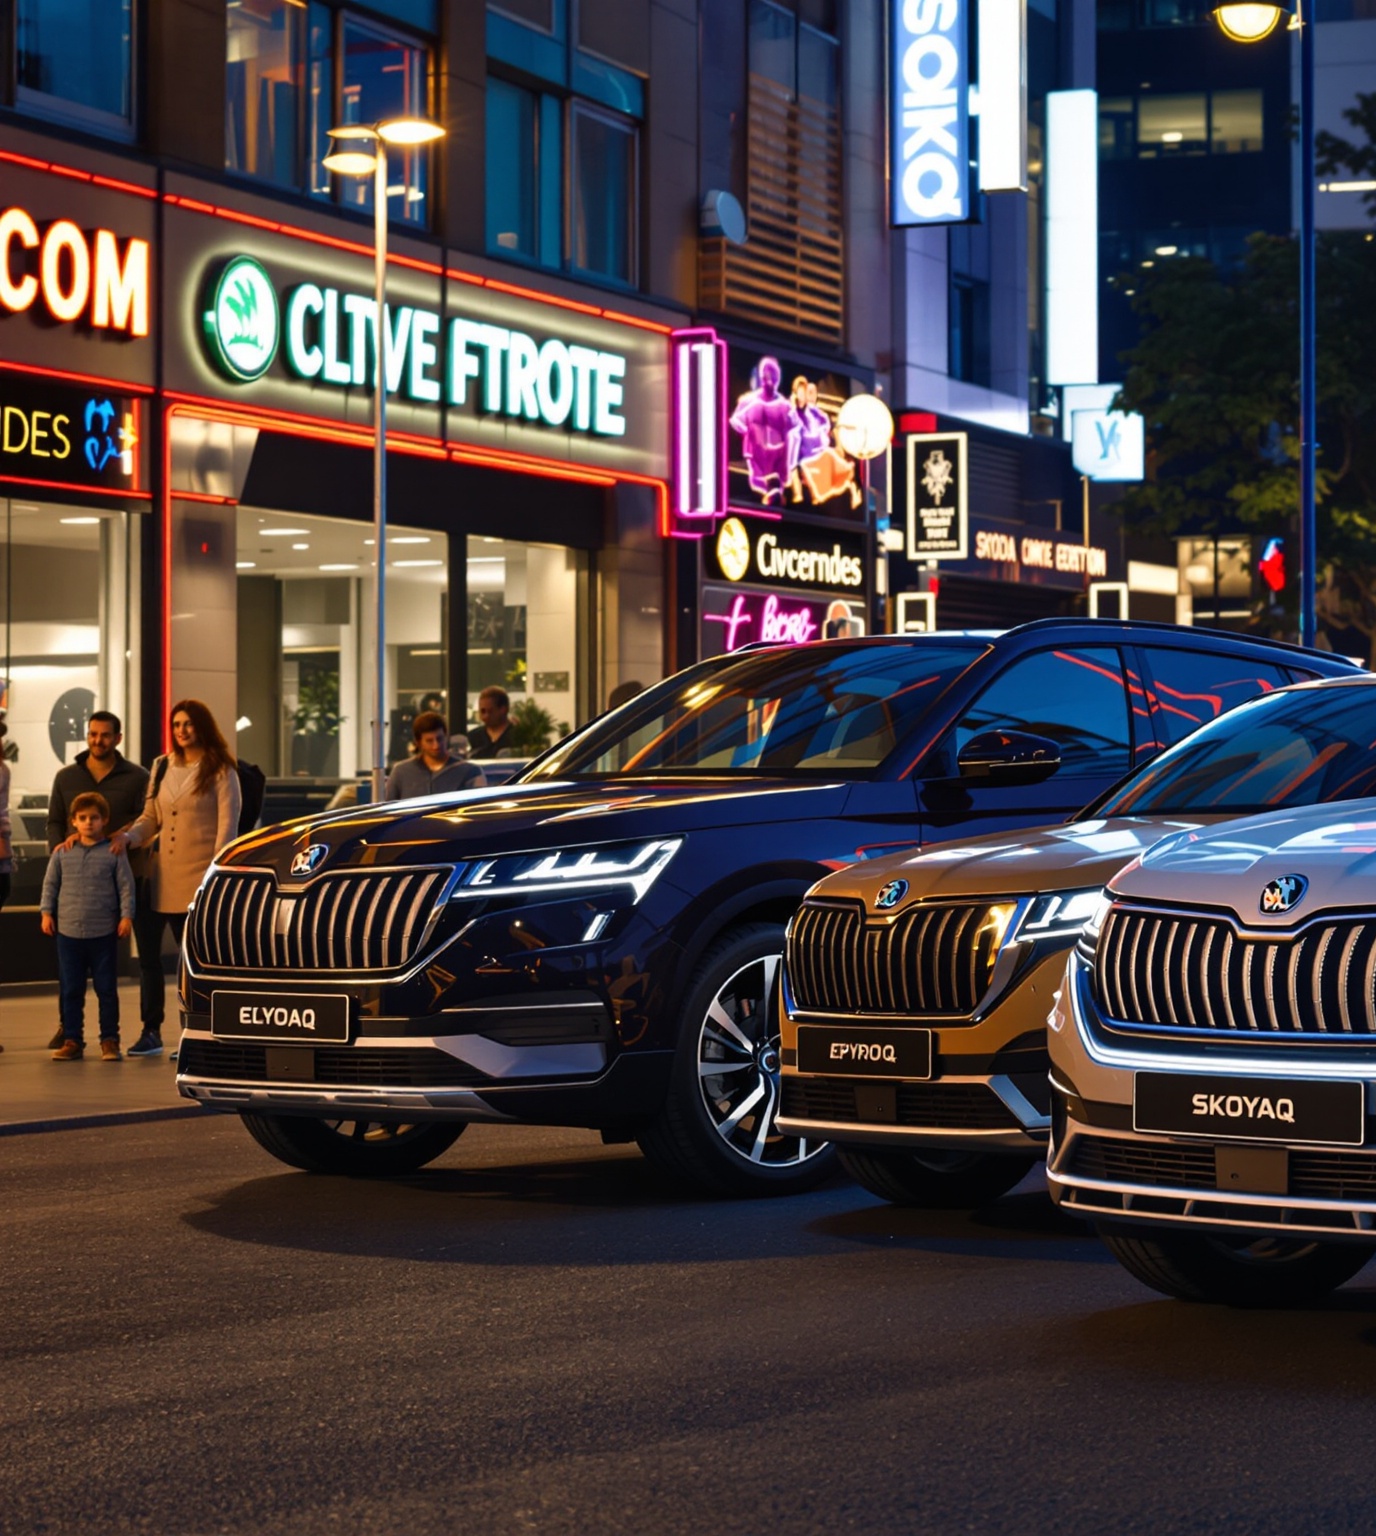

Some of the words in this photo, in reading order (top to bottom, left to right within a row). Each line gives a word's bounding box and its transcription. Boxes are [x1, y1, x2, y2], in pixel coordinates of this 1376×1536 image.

[0, 206, 149, 337] COM
[451, 317, 626, 436] FTROTE
[240, 1006, 316, 1030] ELYOAQ
[1192, 1093, 1296, 1123] SKOYAQ
